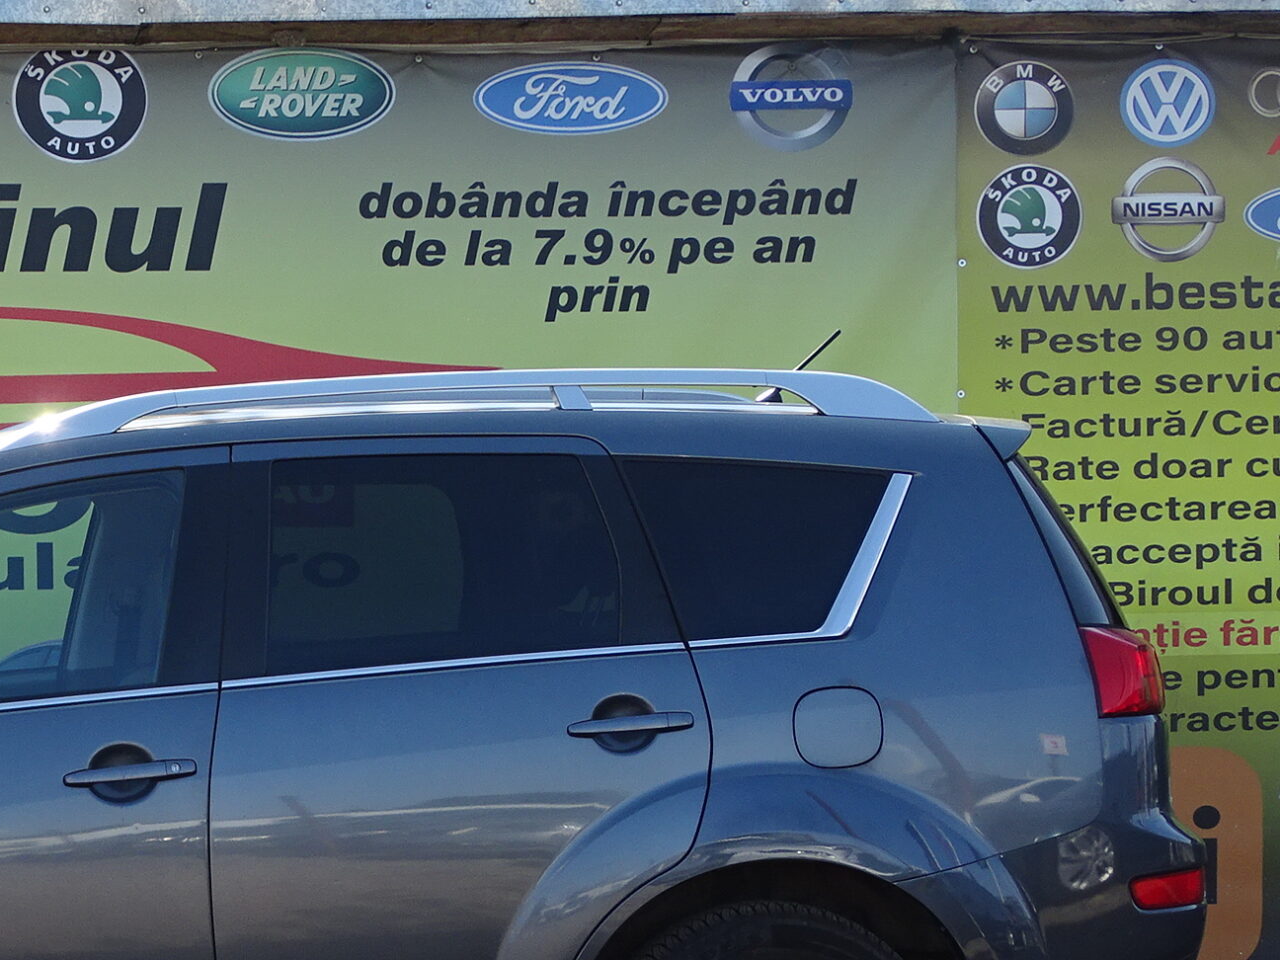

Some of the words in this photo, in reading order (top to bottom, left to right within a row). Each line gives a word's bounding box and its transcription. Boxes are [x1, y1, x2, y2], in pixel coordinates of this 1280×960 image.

[250, 66, 336, 92] LAND
[985, 64, 1066, 93] BMW
[257, 93, 363, 119] ROVER
[514, 74, 627, 121] Ford
[738, 86, 844, 104] VOLVO
[47, 136, 115, 155] AUTO
[988, 168, 1072, 202] ŠKODA
[358, 181, 588, 219] dobânda
[608, 178, 858, 225] începând
[1122, 201, 1214, 219] NISSAN
[382, 231, 445, 266] de
[465, 231, 510, 265] la
[533, 229, 655, 266] 7.9%
[667, 236, 734, 273] pe
[753, 232, 816, 263] an
[1002, 245, 1056, 263] AUTO
[544, 276, 650, 322] prin
[1155, 326, 1208, 352] 90
[1222, 329, 1280, 351] au
[1154, 365, 1280, 394] servic
[1023, 455, 1120, 481] Rate
[1133, 452, 1232, 480] doar
[1091, 536, 1262, 569] acceptă
[1108, 578, 1232, 606] Biroul
[1247, 577, 1280, 604] d
[1220, 619, 1279, 646] făr
[1197, 668, 1280, 697] pen
